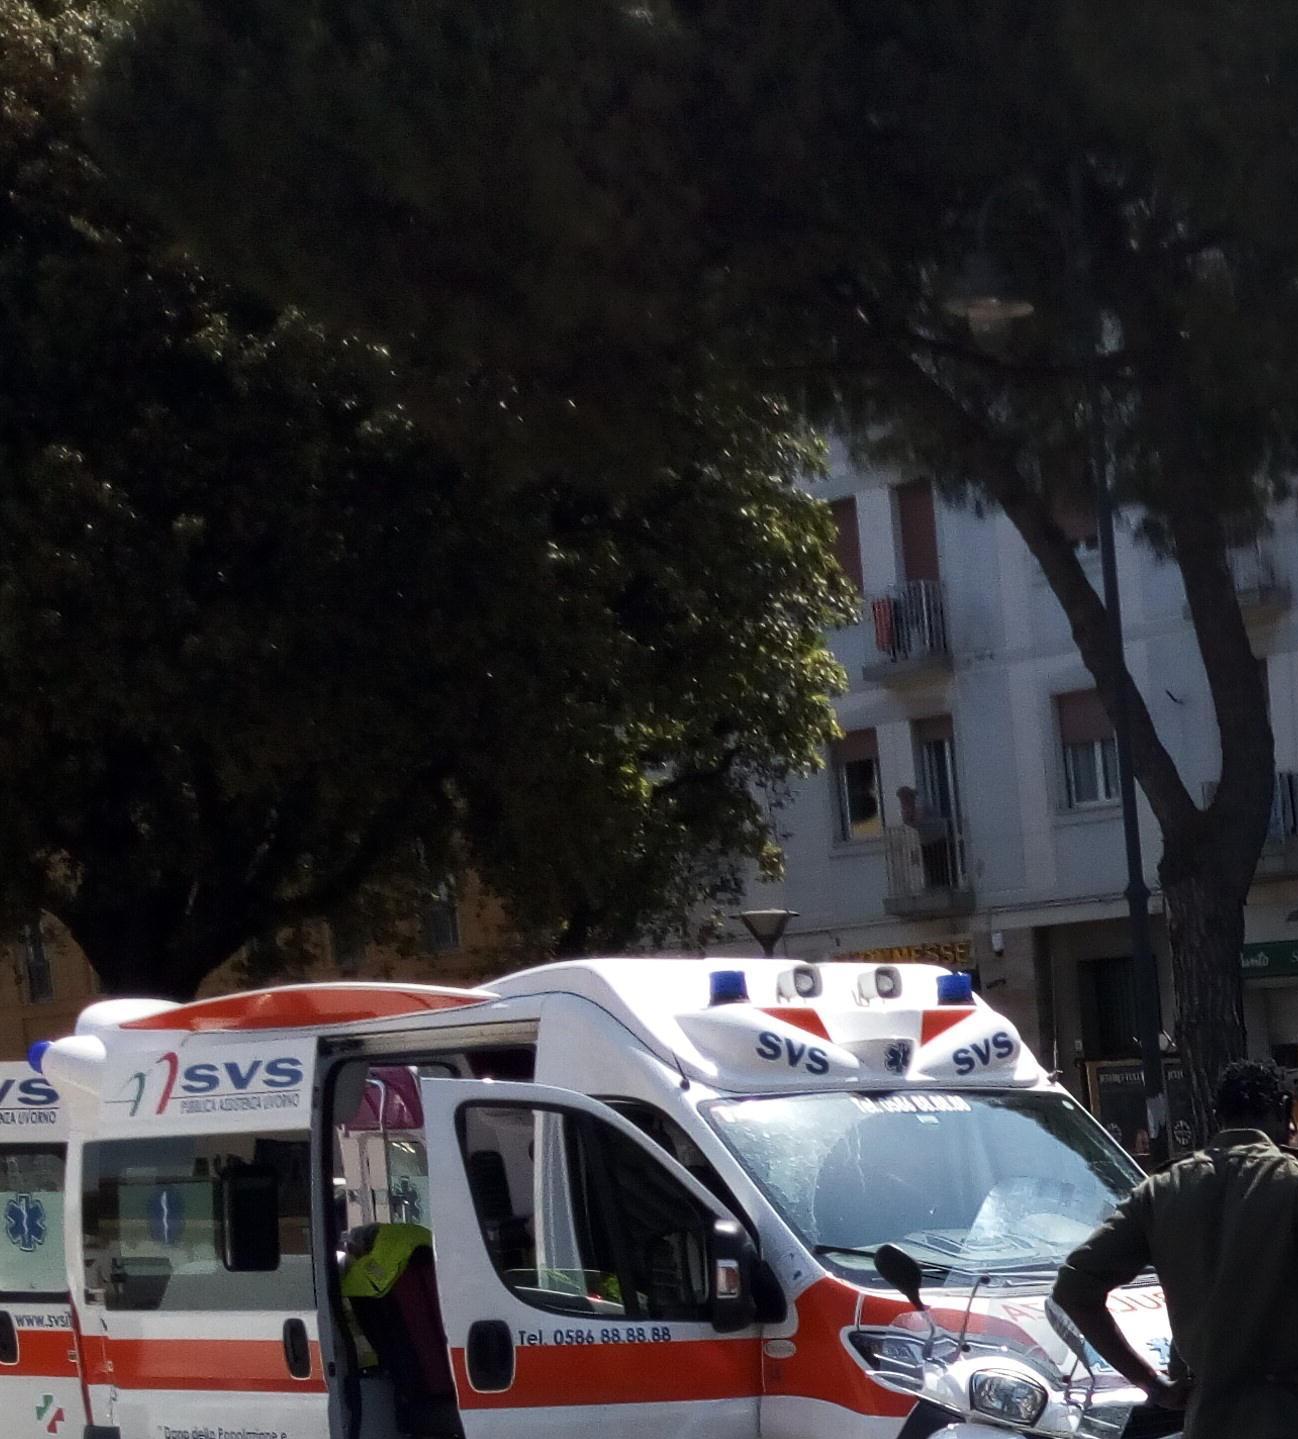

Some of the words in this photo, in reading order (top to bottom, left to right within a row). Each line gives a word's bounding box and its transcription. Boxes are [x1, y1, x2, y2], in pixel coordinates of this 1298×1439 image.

[755, 1031, 830, 1075] SVS
[952, 1031, 1015, 1076] SVS
[181, 1056, 304, 1094] SVS
[518, 1330, 548, 1346] Tel.
[553, 1328, 595, 1345] 0586
[601, 1326, 672, 1344] 88.88.88
